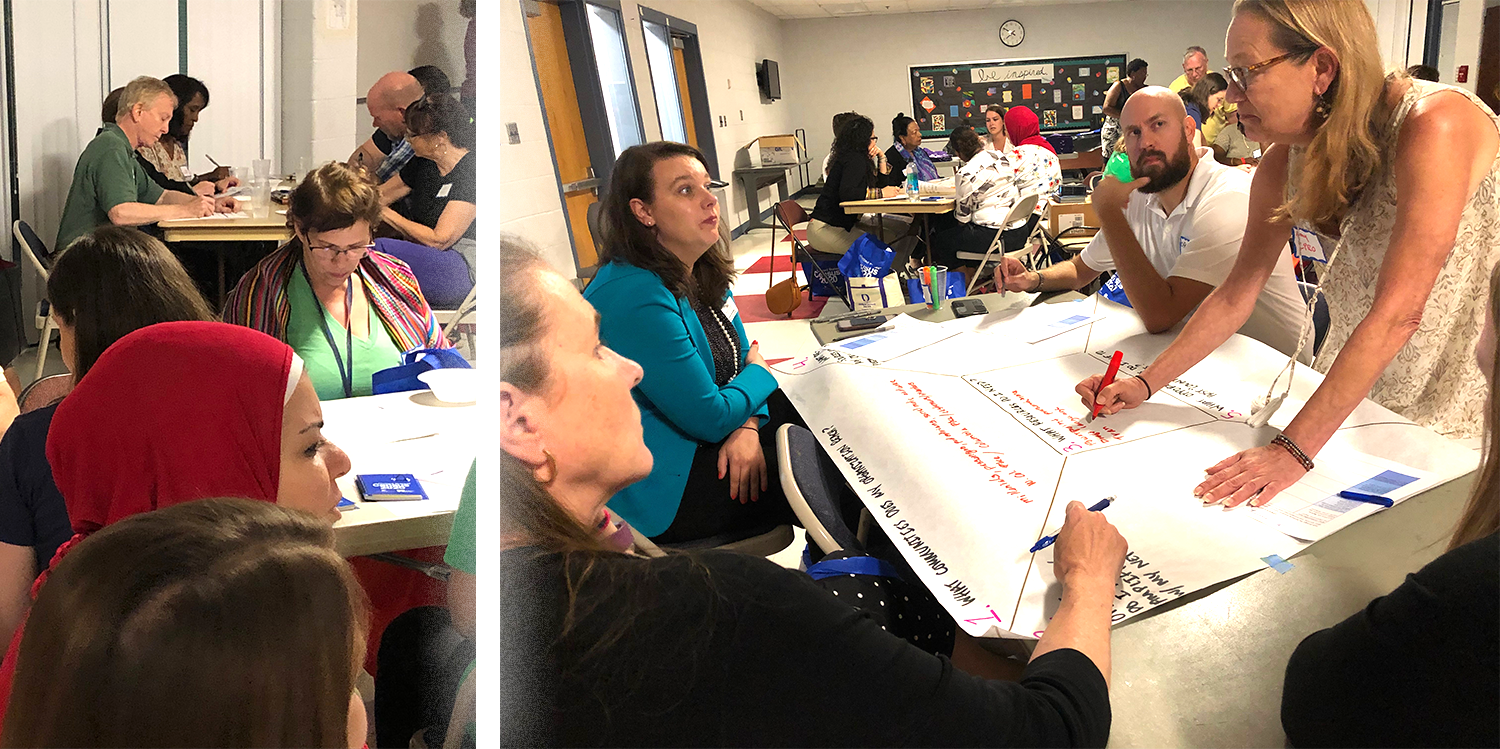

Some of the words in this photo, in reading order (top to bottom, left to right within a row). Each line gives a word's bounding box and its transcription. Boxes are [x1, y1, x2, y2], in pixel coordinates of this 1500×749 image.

[1220, 409, 1242, 420] 5.
[1063, 442, 1082, 452] 3.
[867, 483, 884, 499] MY
[893, 519, 949, 576] COMMUNITIES
[1143, 571, 1169, 587] MY
[944, 579, 976, 607] WHAT
[1126, 600, 1144, 613] DO
